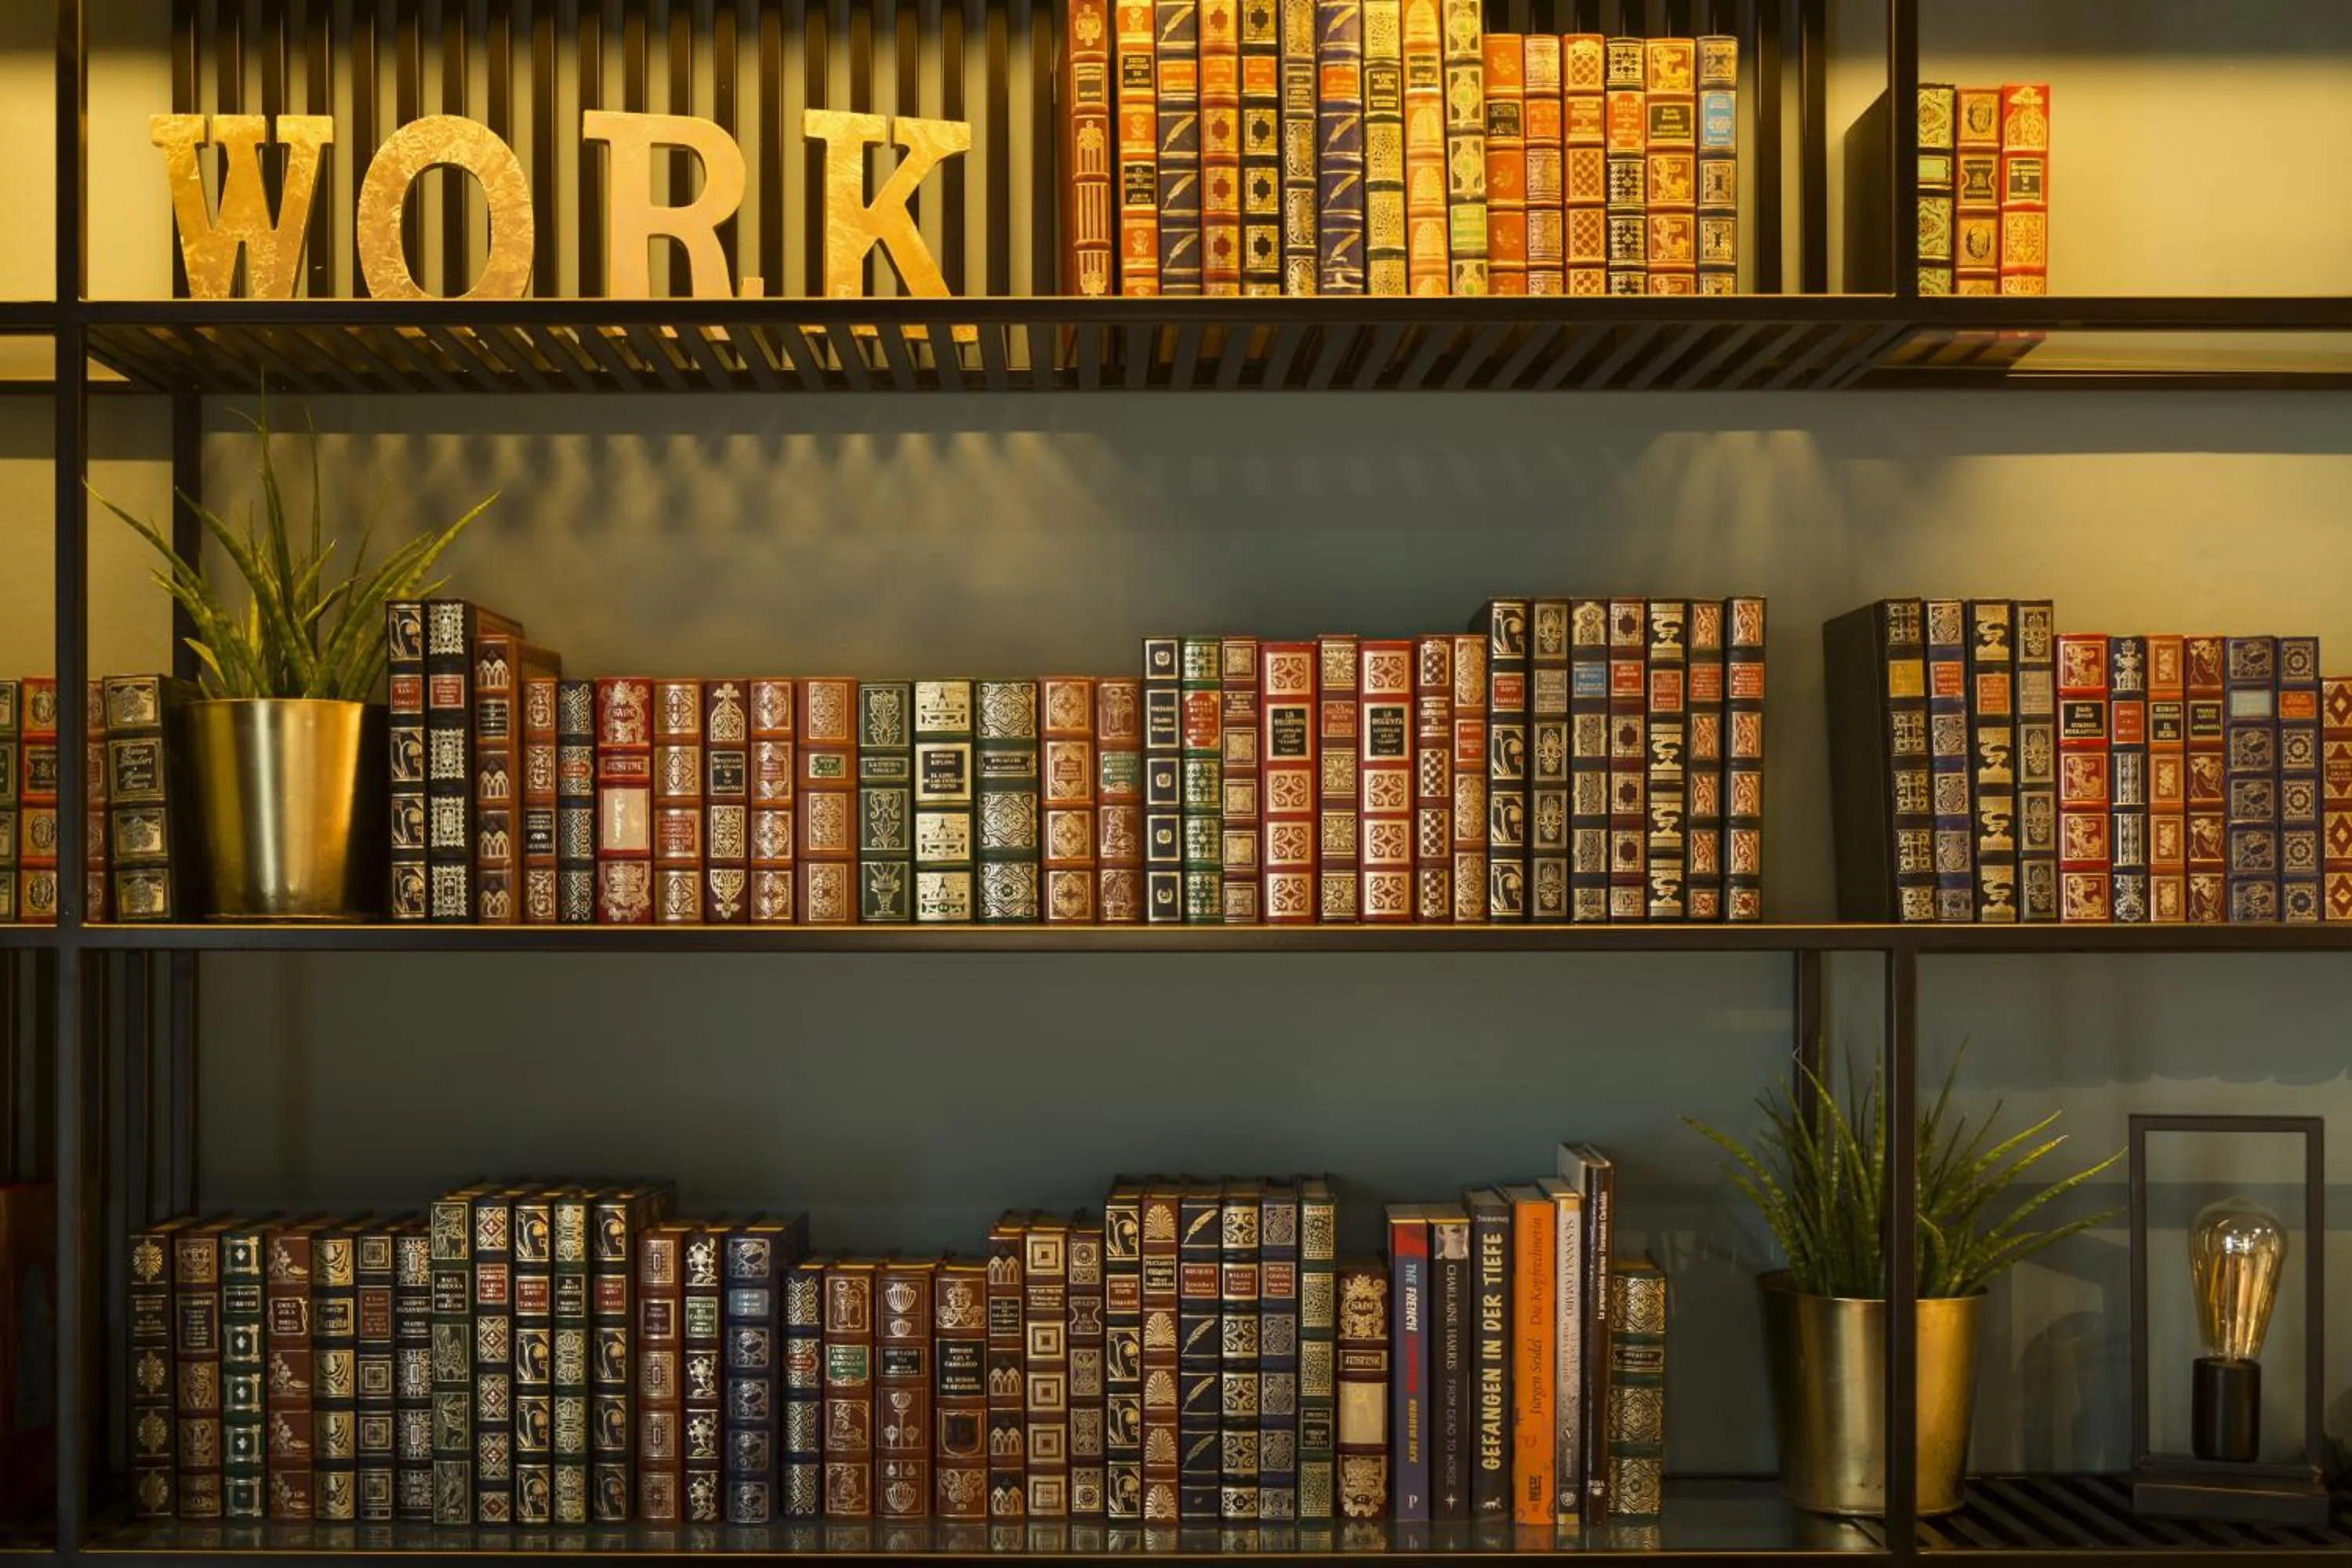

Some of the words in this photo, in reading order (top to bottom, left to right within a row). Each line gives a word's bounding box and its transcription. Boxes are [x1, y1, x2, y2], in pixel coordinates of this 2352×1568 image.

[150, 109, 972, 299] WORK
[1483, 1232, 1503, 1286] TIEFE
[1564, 1219, 1575, 1270] SUSANNA
[1405, 1263, 1417, 1285] THE
[1446, 1264, 1457, 1327] CHARLAINE
[1563, 1272, 1575, 1316] TAMARO
[1405, 1286, 1418, 1331] FRENCH
[1482, 1294, 1502, 1330] DER
[1530, 1305, 1543, 1326] Die
[1446, 1329, 1457, 1370] HARRIS
[1482, 1339, 1502, 1359] IN
[1530, 1337, 1543, 1373] Seidel
[1481, 1367, 1502, 1470] GEFANGEN
